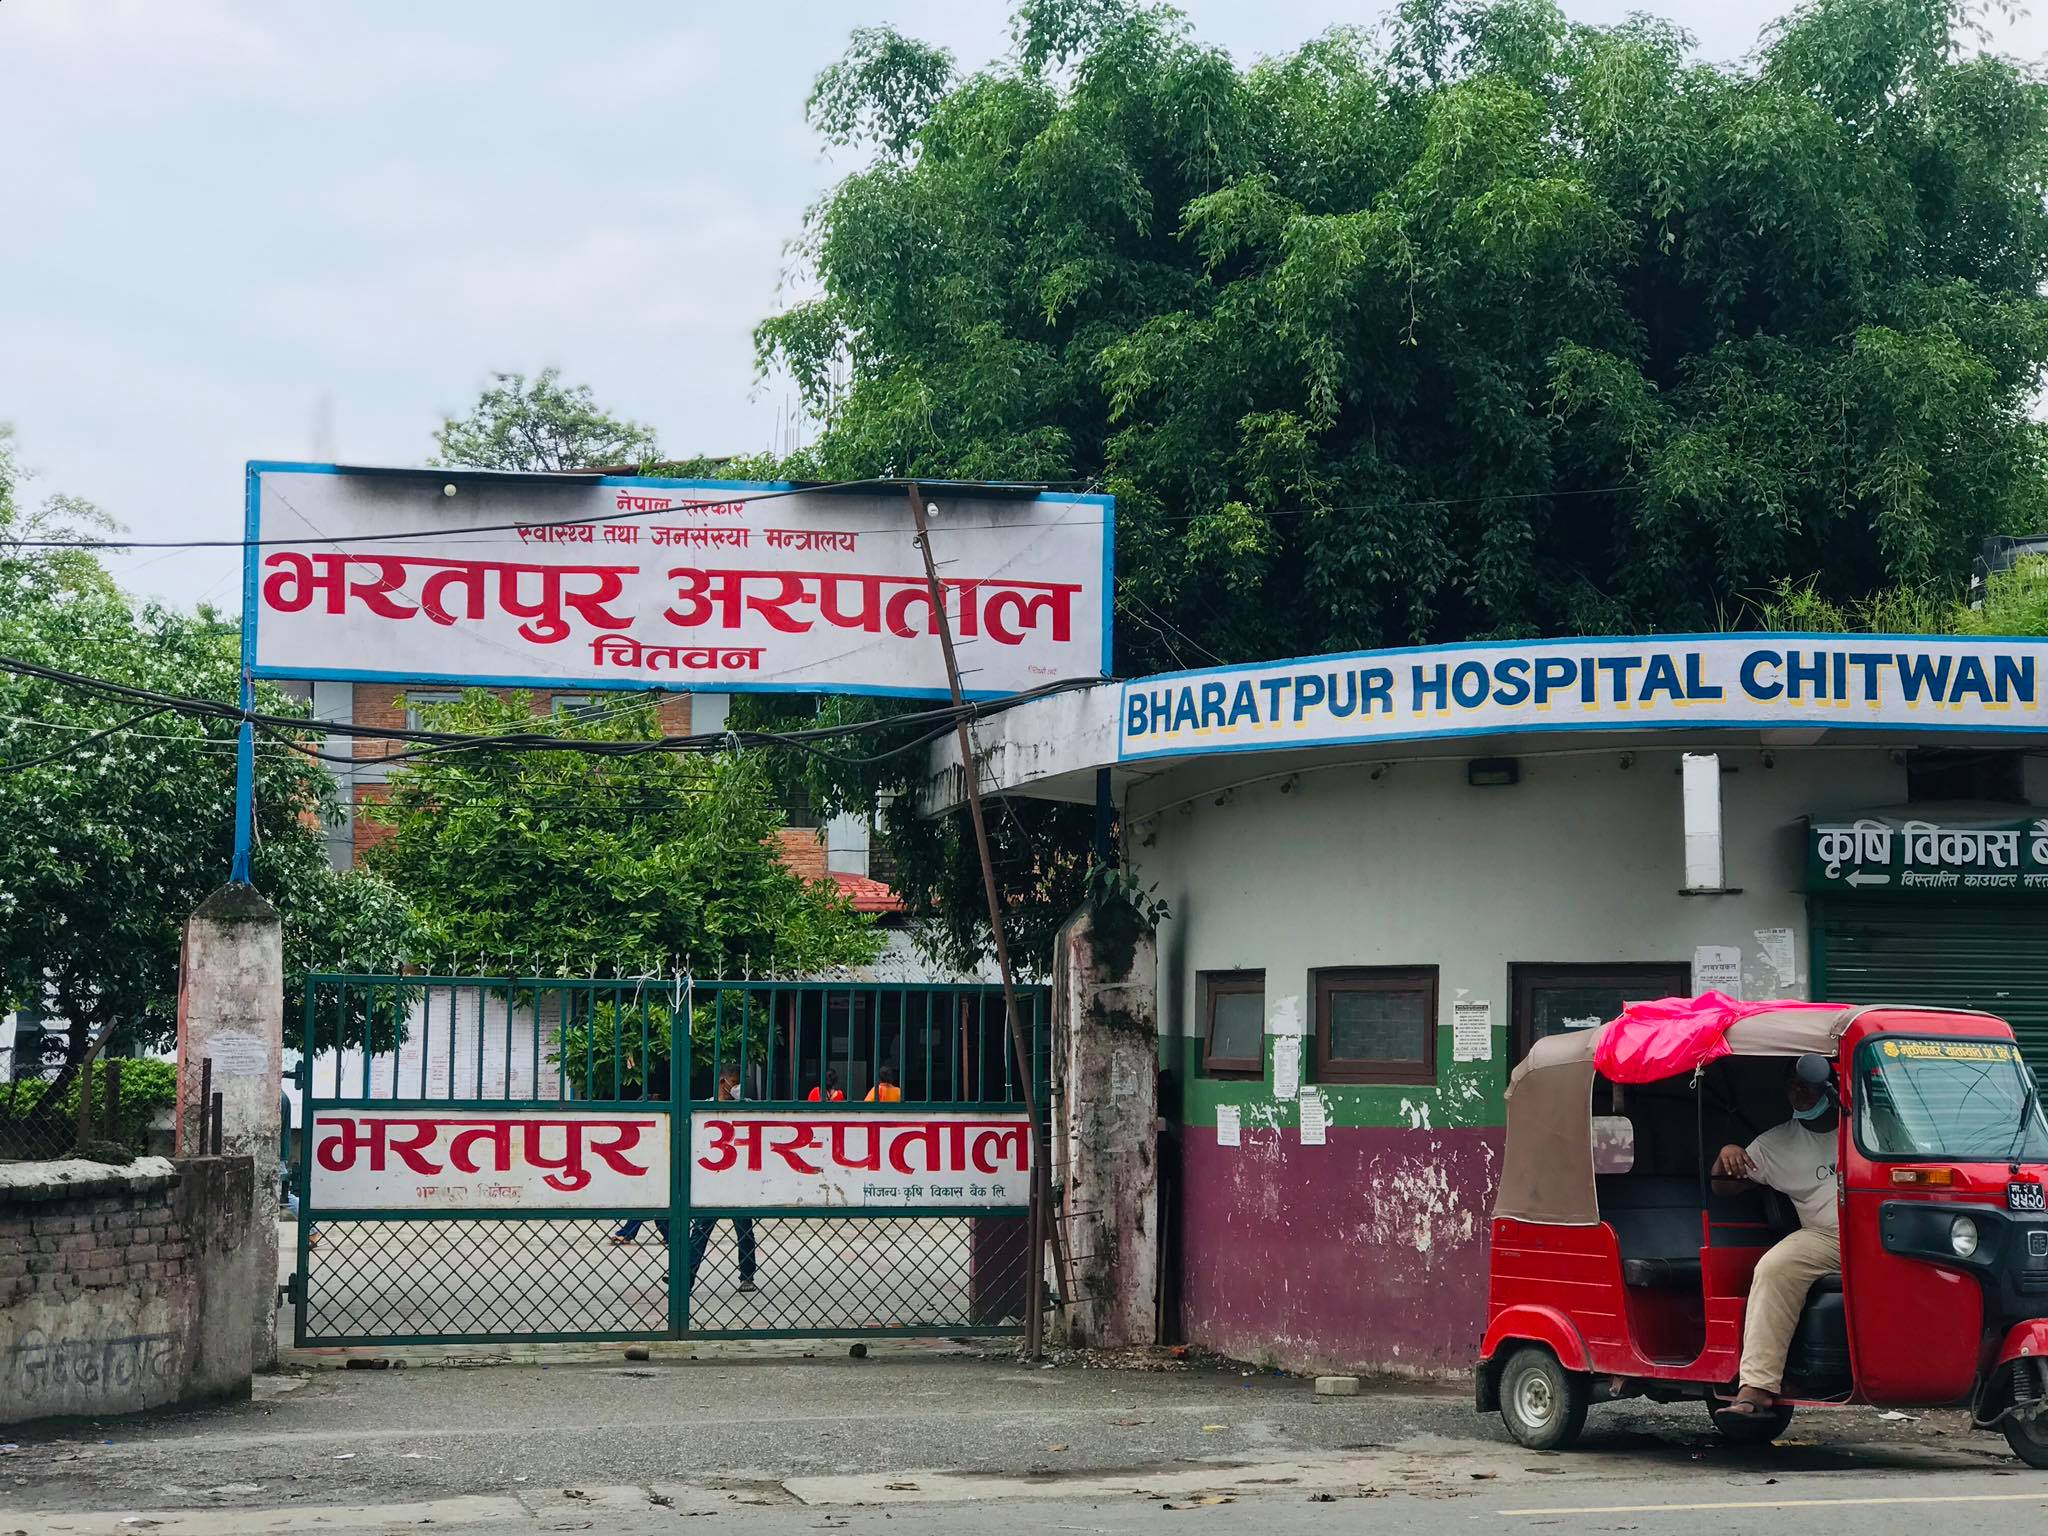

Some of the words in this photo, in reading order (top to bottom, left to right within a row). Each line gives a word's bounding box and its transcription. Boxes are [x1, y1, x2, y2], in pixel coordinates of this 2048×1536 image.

[616, 490, 672, 515] नेपाल
[681, 498, 746, 518] सरकार
[603, 525, 640, 545] तथा
[650, 523, 750, 549] जनसंख्या
[764, 528, 859, 552] मन्त्रालय
[263, 551, 640, 644] भरतपुर
[663, 566, 1083, 645] अस्पताल
[588, 633, 768, 673] चितवन
[1127, 667, 1394, 737] BHARATPUR
[1411, 652, 1724, 712] HOSPITAL
[1739, 649, 2035, 703] CHITWAN
[1817, 819, 1894, 879] कृषि
[1901, 820, 2020, 868] विकास
[316, 1118, 657, 1192] भरतपुर
[697, 1120, 1032, 1175] अस्पताल
[903, 1184, 924, 1201] कृषि
[930, 1184, 963, 1199] विकास
